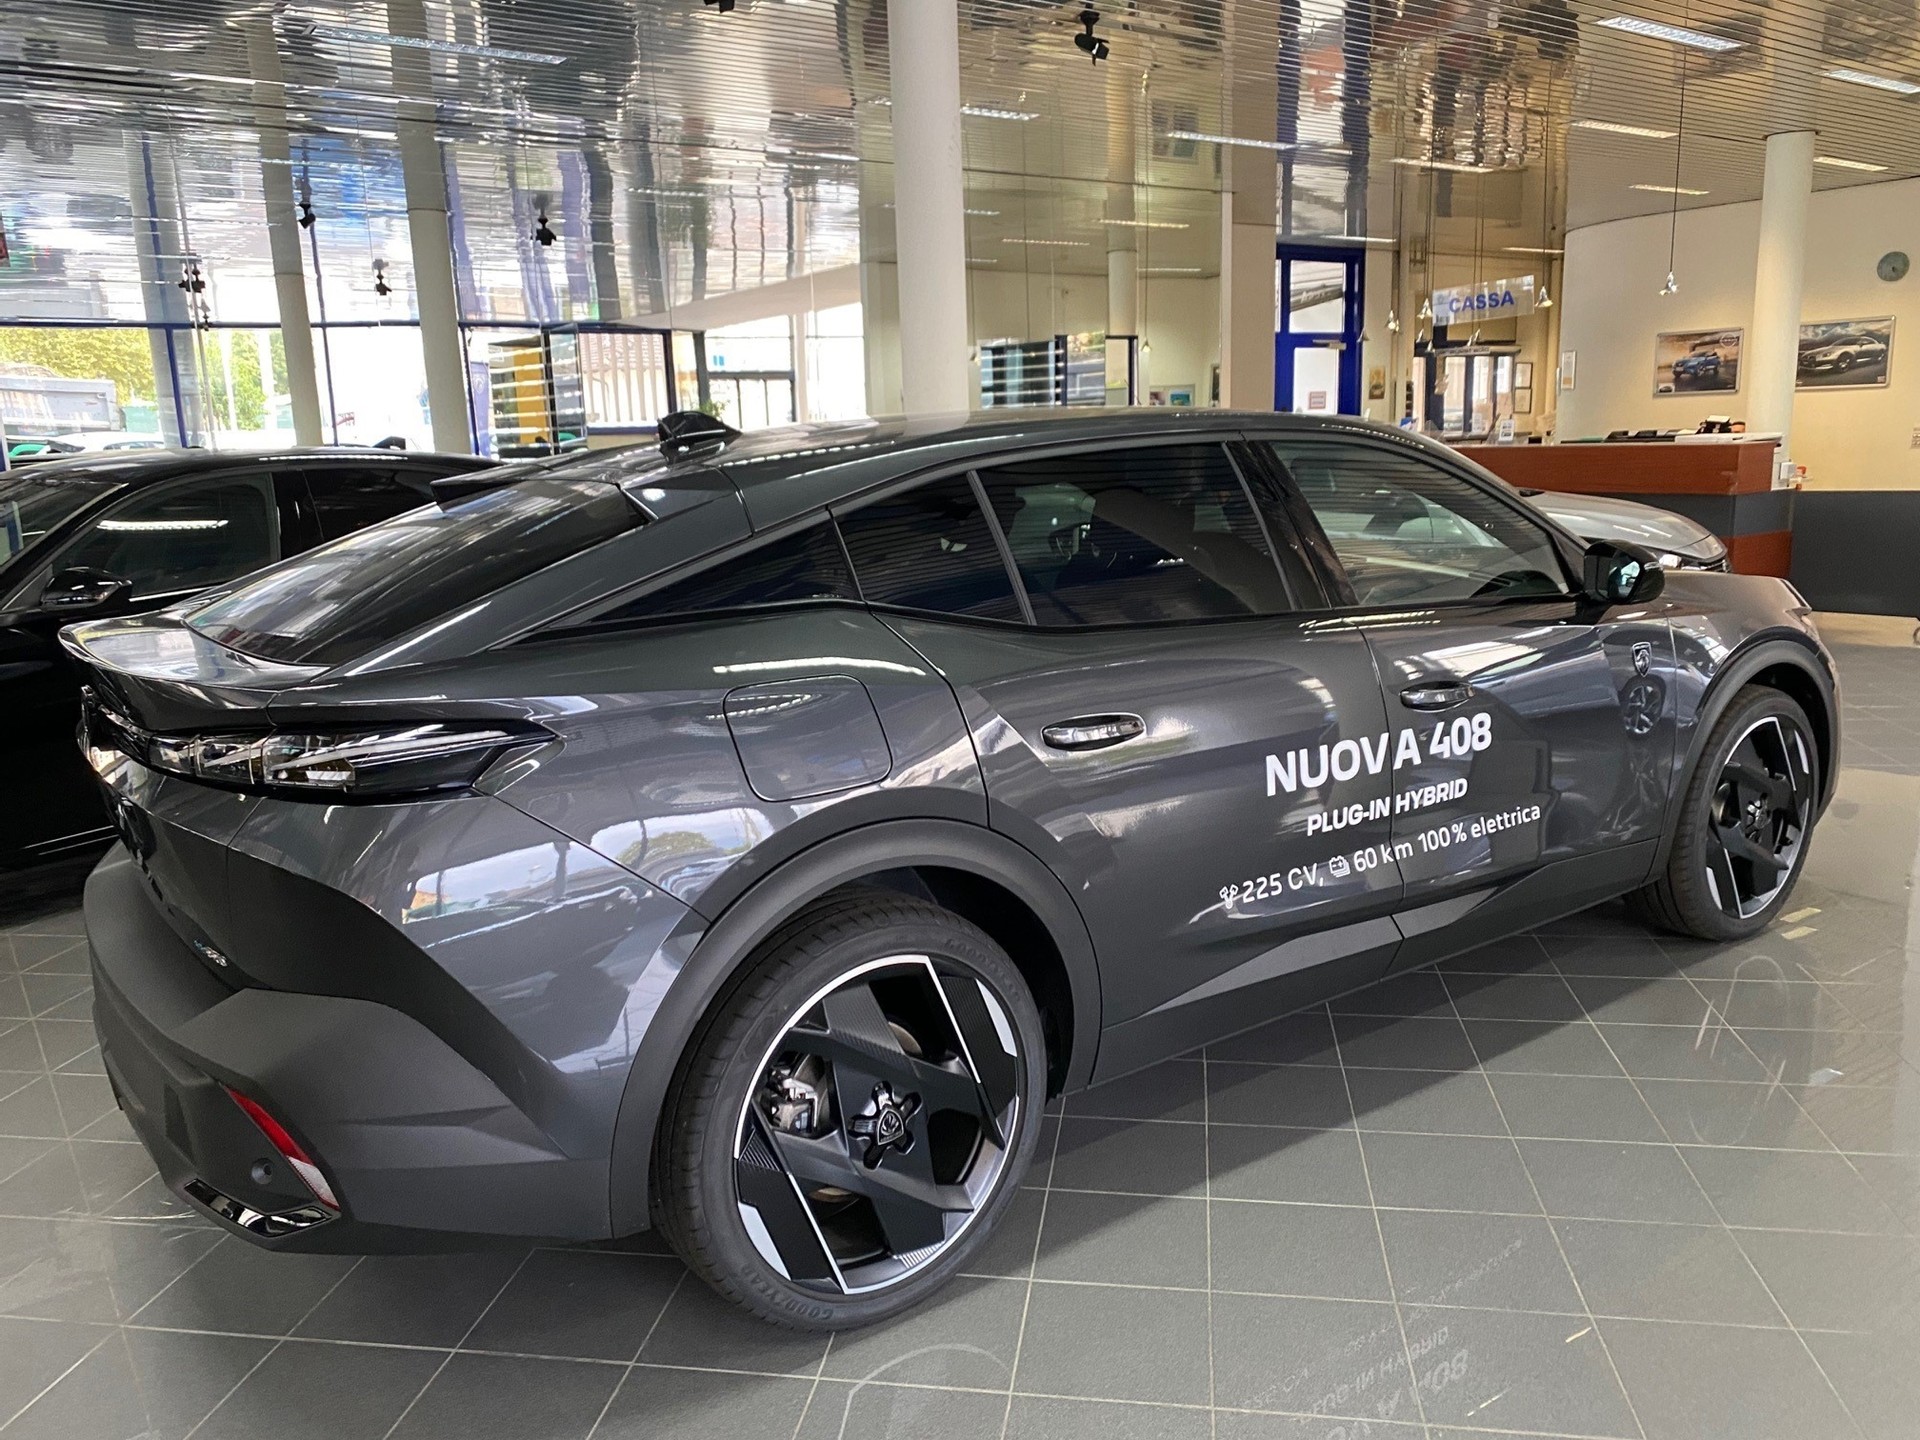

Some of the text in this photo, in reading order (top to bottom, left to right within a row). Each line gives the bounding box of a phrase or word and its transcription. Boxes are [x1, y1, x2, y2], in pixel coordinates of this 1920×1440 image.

[1448, 290, 1515, 313] CASSA
[1265, 712, 1492, 797] NUOVA 408
[1306, 777, 1468, 836] PLUG-IN HYBRID
[1241, 804, 1541, 904] 225 CV, 60 km 100% elettrica
